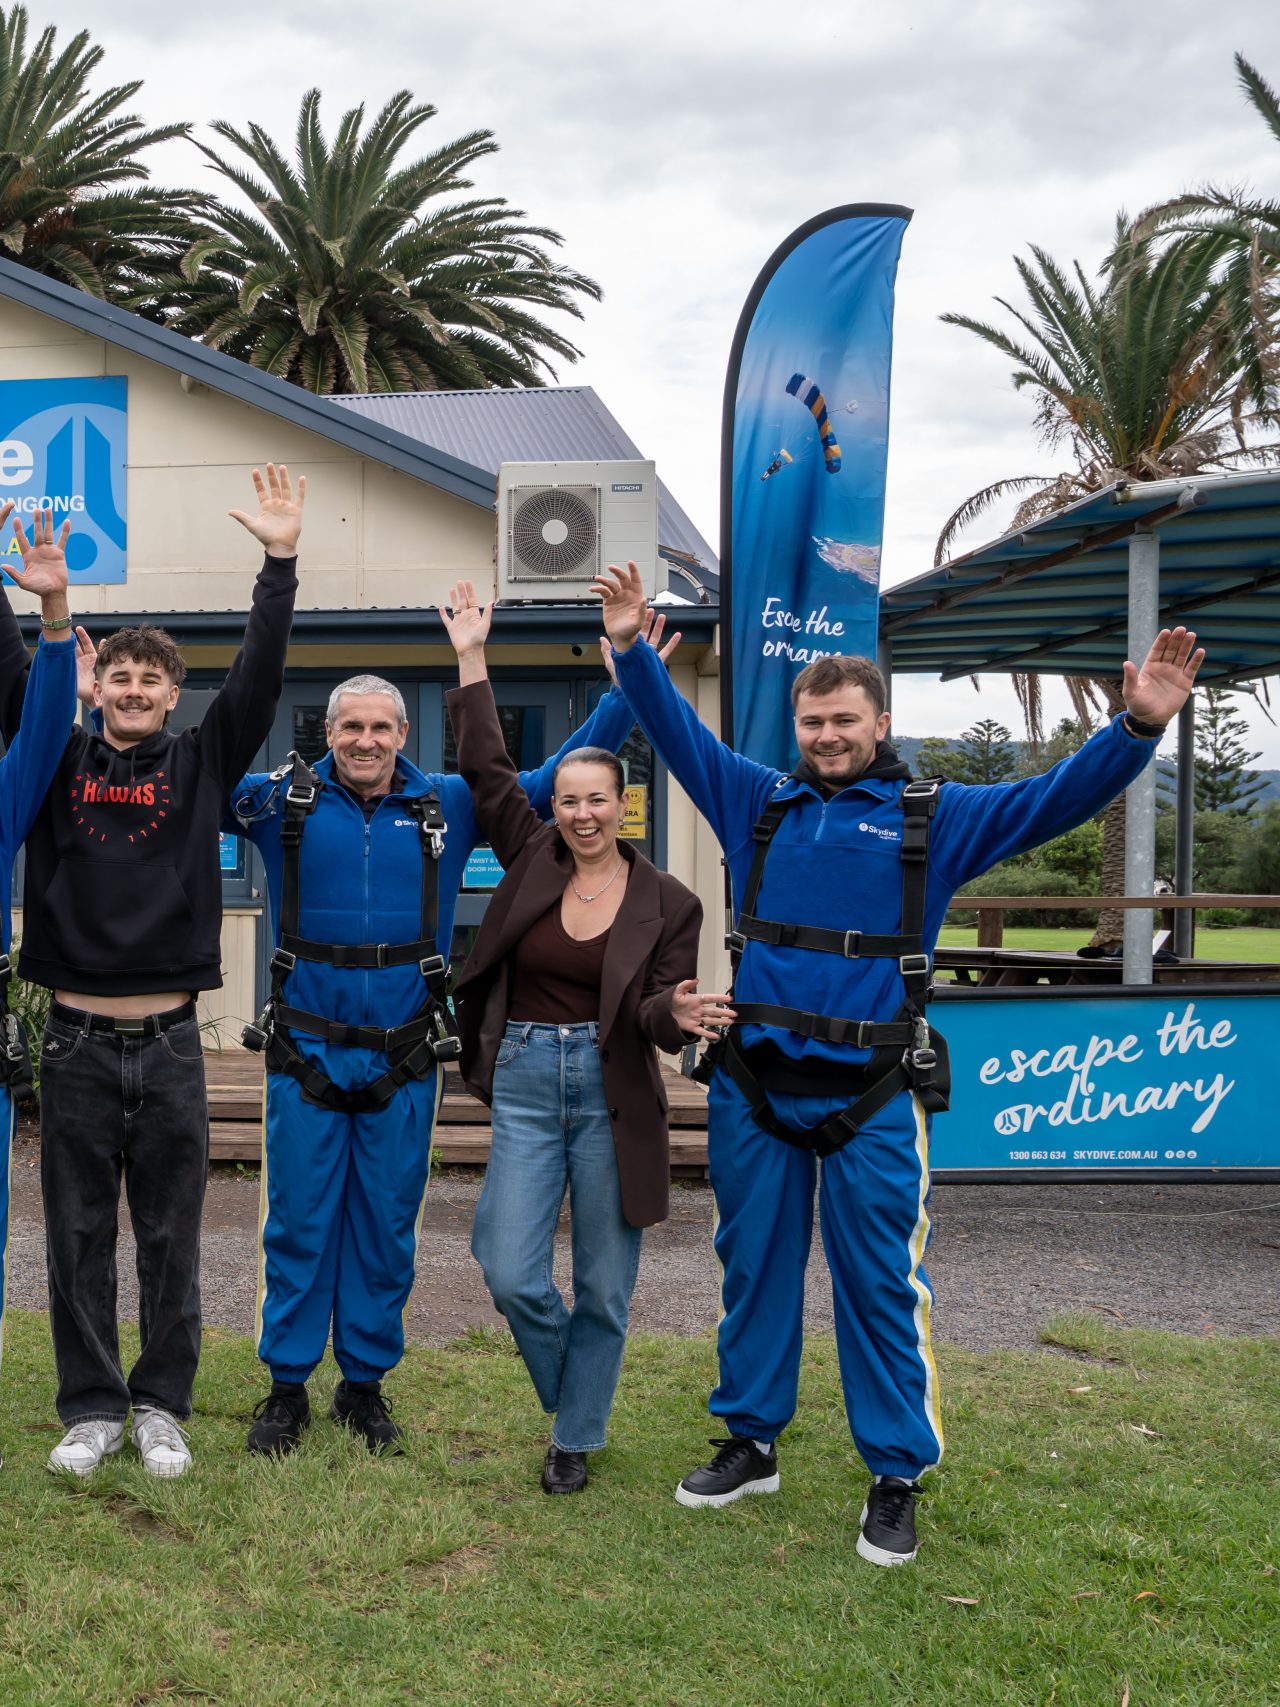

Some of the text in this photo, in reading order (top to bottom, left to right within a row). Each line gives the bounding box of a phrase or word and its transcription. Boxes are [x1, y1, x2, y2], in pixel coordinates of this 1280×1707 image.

[804, 605, 845, 637] the
[868, 825, 898, 837] Skydive
[979, 1003, 1238, 1096] escape the
[993, 1073, 1236, 1135] ordinary
[1009, 1150, 1158, 1160] 1300 663 634 SKYDIVE.COM.AU
